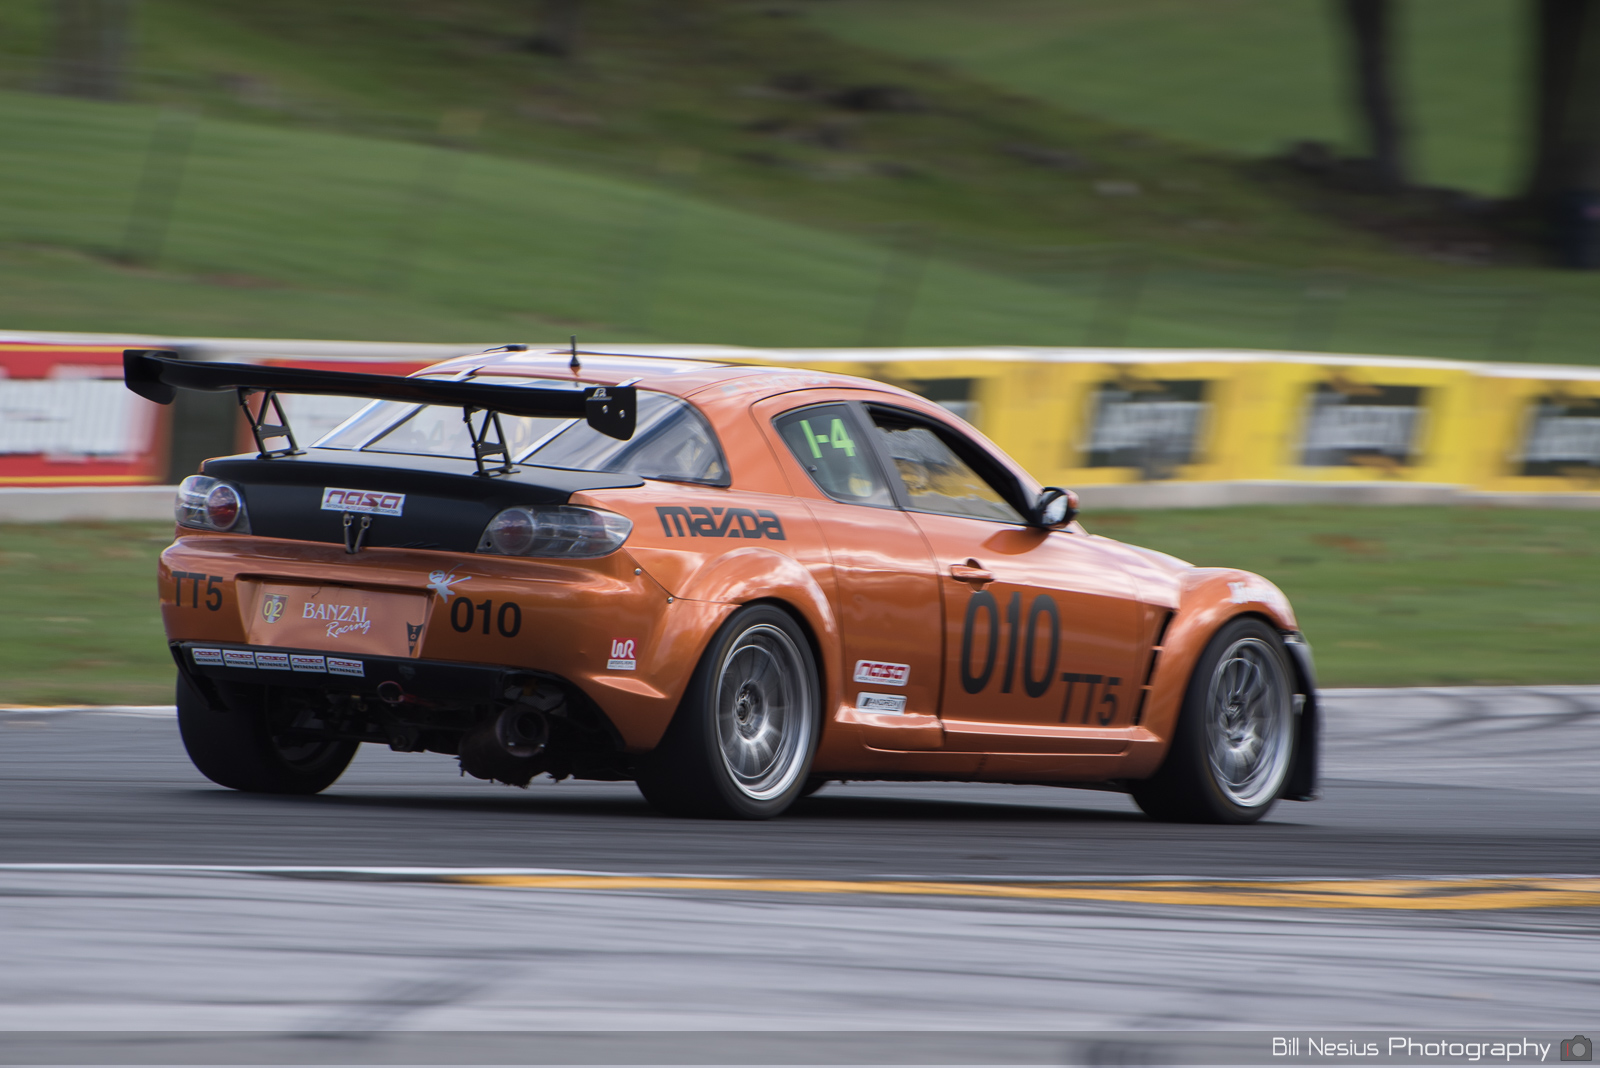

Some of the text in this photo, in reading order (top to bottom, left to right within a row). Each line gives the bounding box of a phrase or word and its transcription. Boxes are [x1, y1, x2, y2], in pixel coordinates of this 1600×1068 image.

[326, 490, 402, 509] nasa
[172, 571, 223, 611] TT5
[302, 602, 367, 622] BANZAI
[450, 597, 522, 637] 010
[326, 620, 370, 637] Racing
[611, 639, 635, 658] WR
[961, 590, 1061, 698] 010
[1061, 672, 1121, 726] TT5
